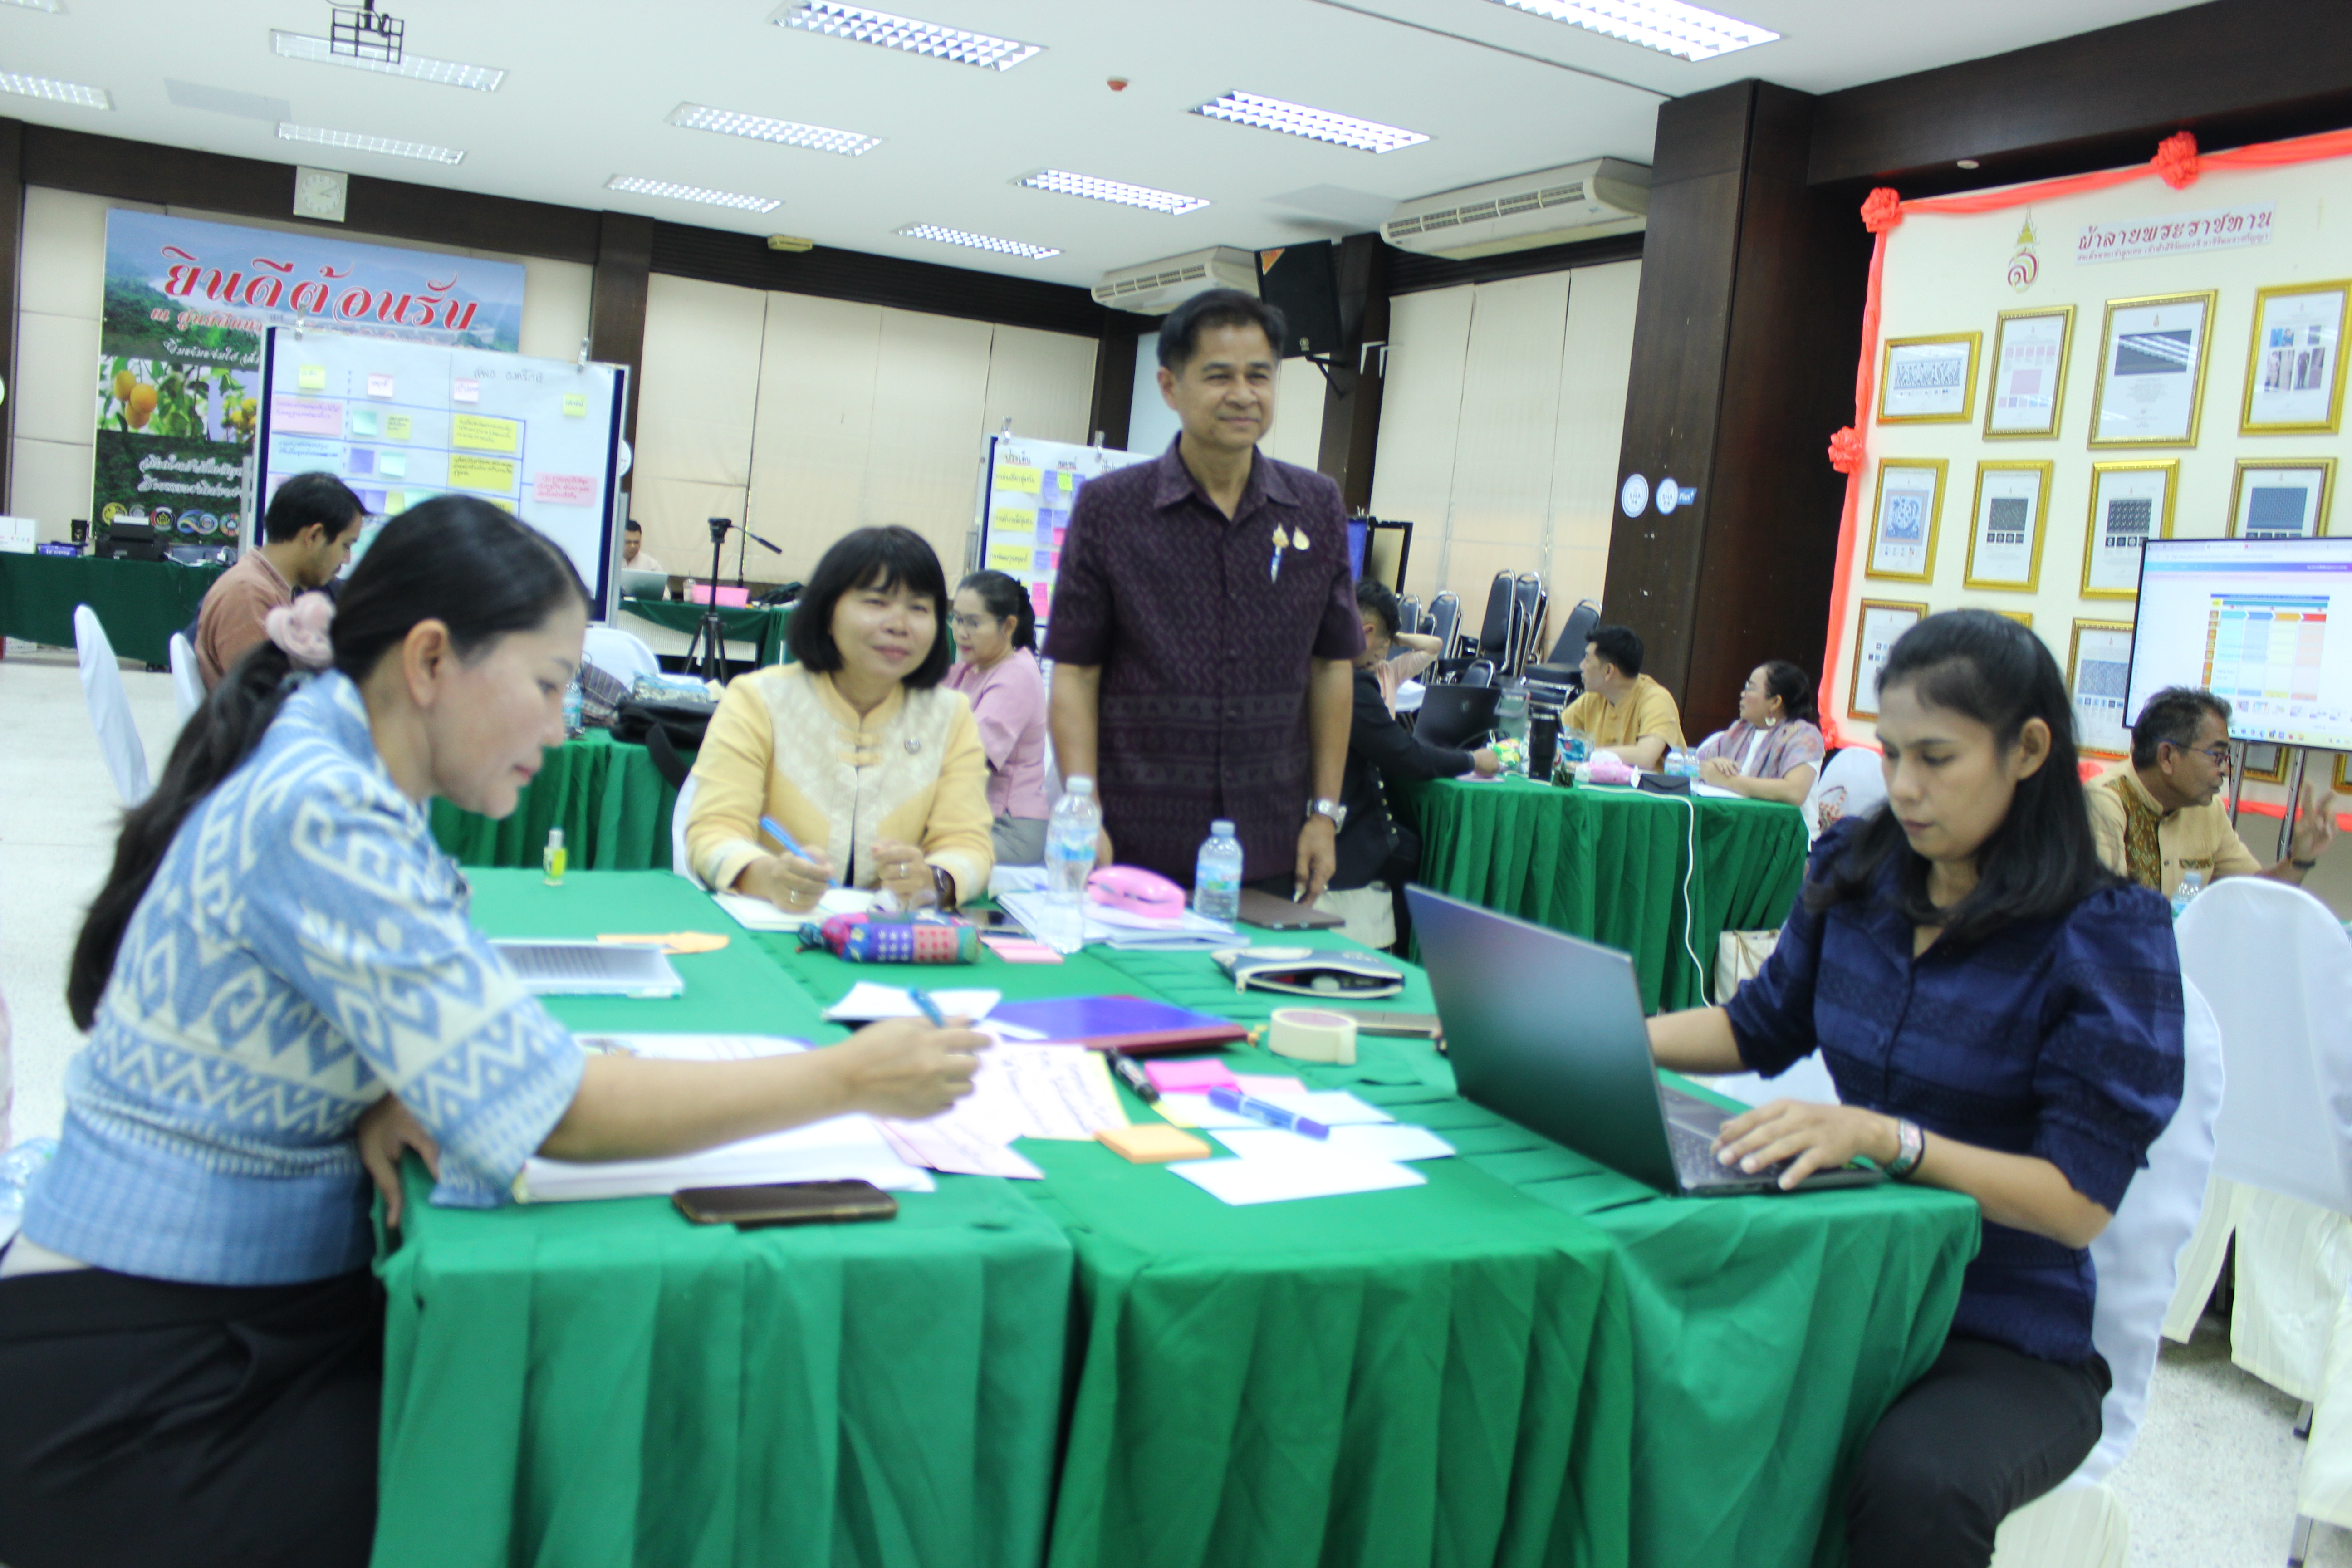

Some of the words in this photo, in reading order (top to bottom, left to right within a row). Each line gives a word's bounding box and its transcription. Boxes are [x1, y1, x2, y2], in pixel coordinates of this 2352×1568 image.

[2078, 210, 2272, 250] ผ้าลายพระราชทาน
[162, 245, 479, 330] ยินดีต้อนรับ
